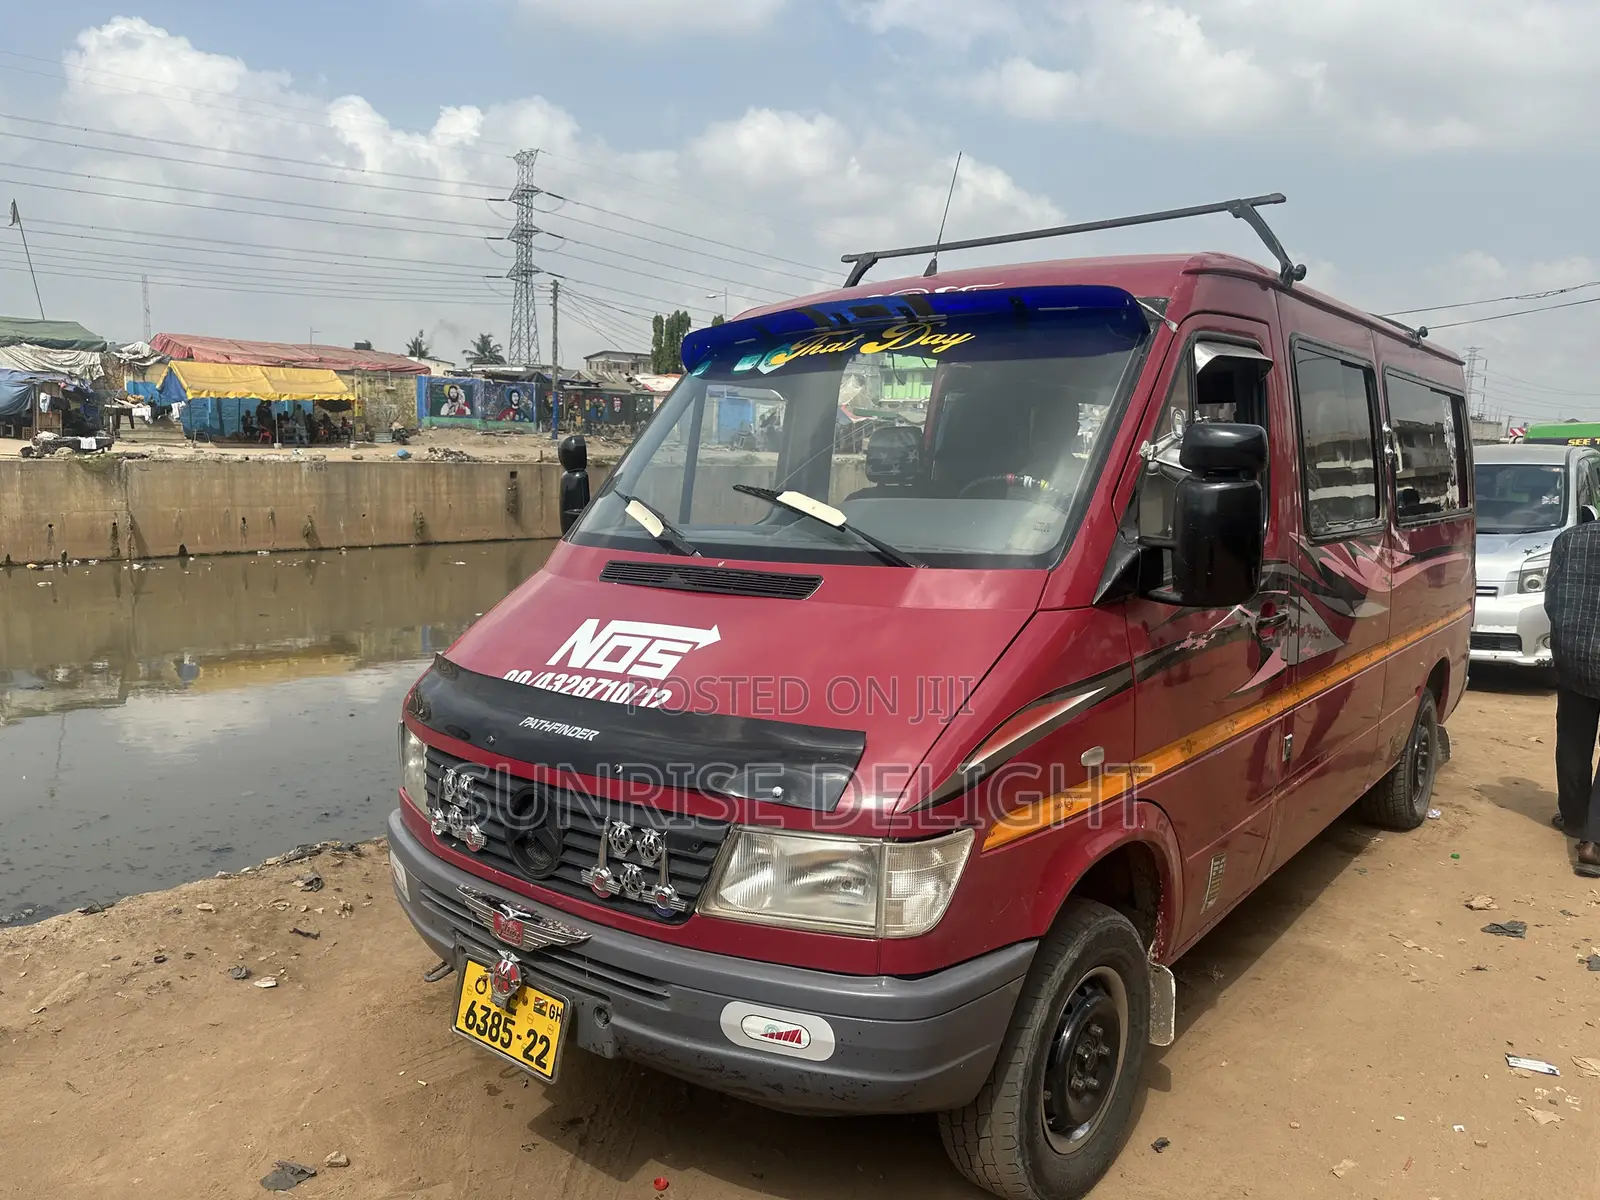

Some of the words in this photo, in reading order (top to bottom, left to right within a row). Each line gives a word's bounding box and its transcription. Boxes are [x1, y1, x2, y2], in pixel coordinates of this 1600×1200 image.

[770, 328, 866, 366] That
[859, 322, 976, 354] Day
[545, 618, 696, 680] NOS
[519, 716, 600, 742] PATHFINDER
[465, 1000, 550, 1069] 6385-22
[549, 1003, 563, 1023] GH
